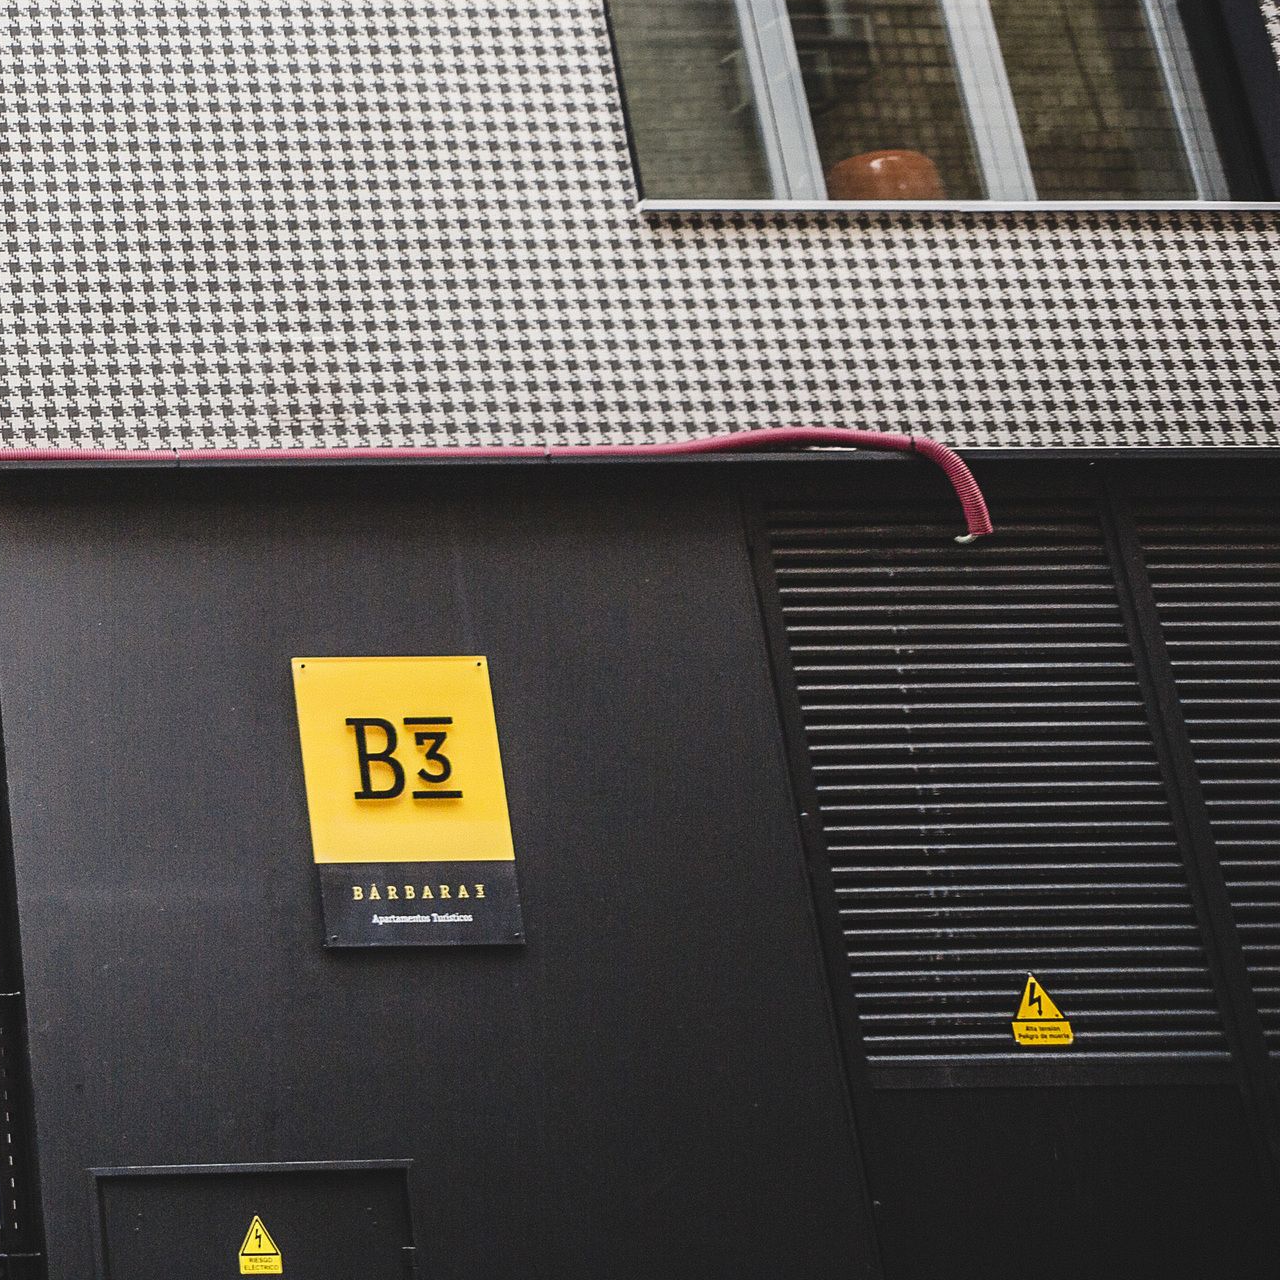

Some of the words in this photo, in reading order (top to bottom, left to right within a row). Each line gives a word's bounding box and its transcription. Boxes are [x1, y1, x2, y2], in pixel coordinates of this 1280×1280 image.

[345, 716, 463, 800] B3
[371, 913, 431, 926] Apartamentos
[431, 912, 474, 923] Turísticos
[1018, 1032, 1039, 1040] Peligro
